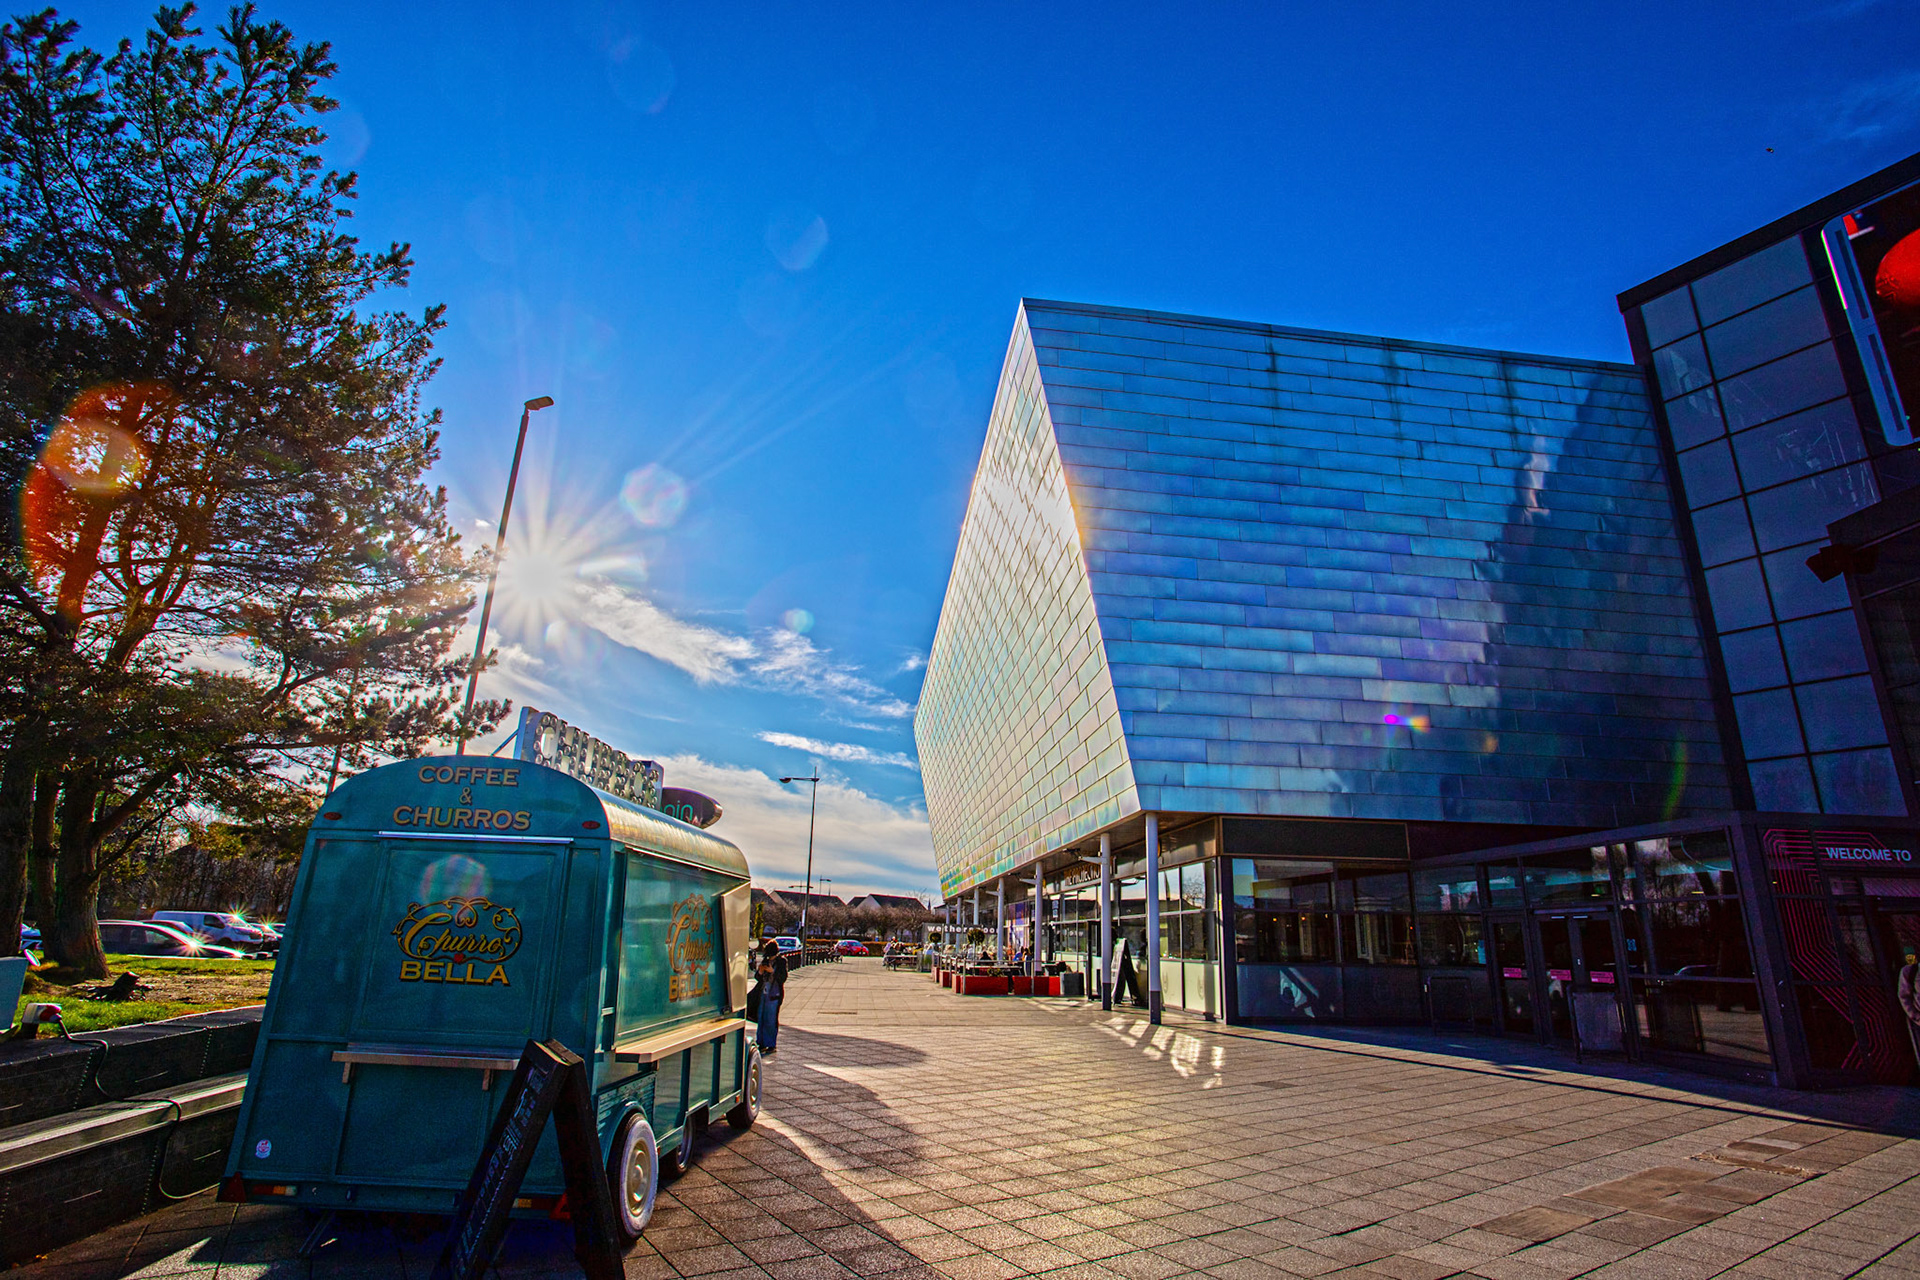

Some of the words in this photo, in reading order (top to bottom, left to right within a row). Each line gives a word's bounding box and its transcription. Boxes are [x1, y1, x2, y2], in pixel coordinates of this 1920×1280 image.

[418, 765, 520, 787] COFFEE
[459, 786, 473, 805] &
[393, 805, 532, 831] CHURROS
[1825, 847, 1893, 861] WELCOME
[1892, 849, 1912, 862] TO
[404, 912, 505, 959] Churro
[400, 960, 511, 987] BELLA
[669, 970, 711, 1003] BELLA
